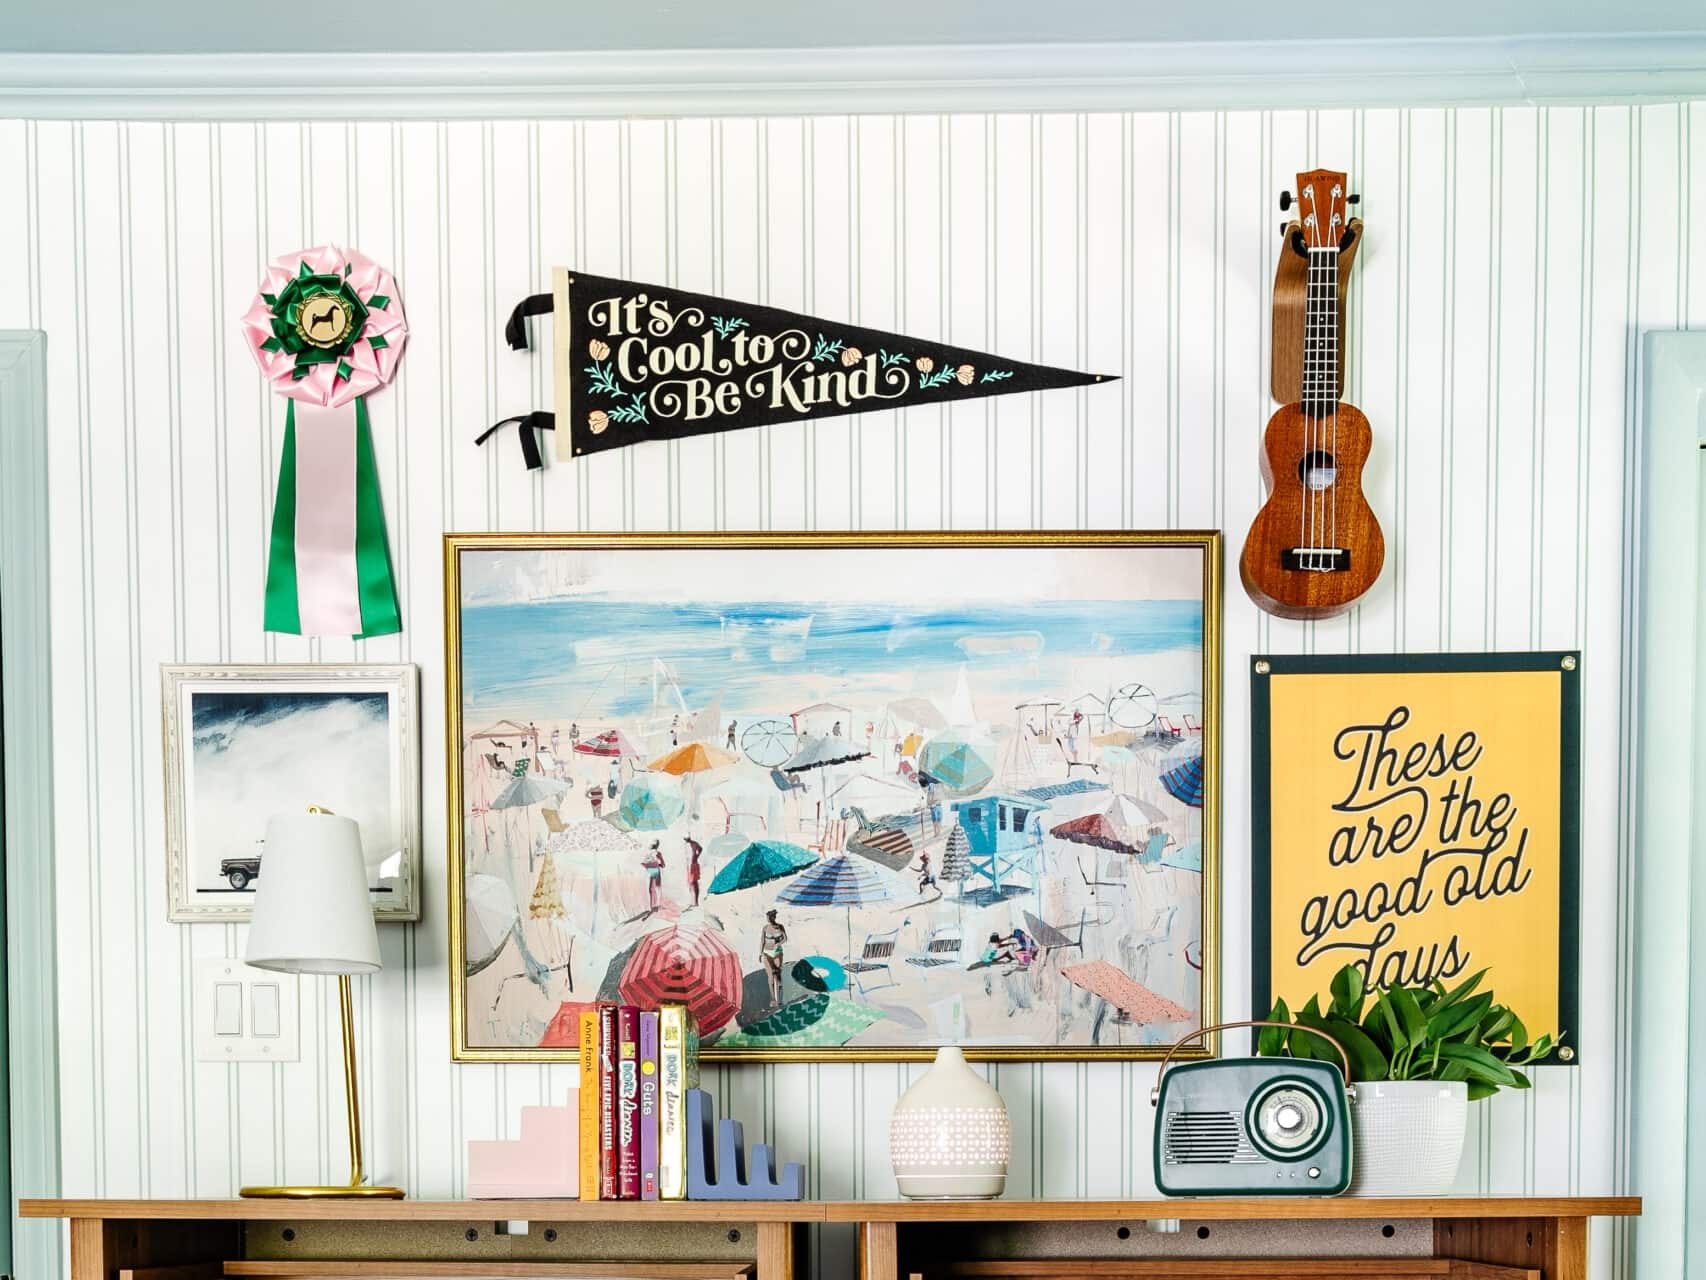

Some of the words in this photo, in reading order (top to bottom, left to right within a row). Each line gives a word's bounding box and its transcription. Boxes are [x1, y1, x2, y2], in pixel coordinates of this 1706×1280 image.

[588, 294, 704, 336] It's
[618, 330, 733, 384] Cool
[732, 329, 811, 367] to
[650, 378, 741, 421] Be
[745, 354, 910, 413] Kind
[1333, 705, 1484, 813] These
[1328, 790, 1429, 867] are
[1440, 776, 1518, 845] the
[1297, 849, 1434, 967] good
[1444, 828, 1533, 905] old
[1343, 923, 1472, 996] days
[585, 1020, 594, 1045] Anne
[584, 1047, 595, 1073] Frank
[622, 1063, 634, 1098] DORK
[665, 1054, 679, 1087] DORK
[643, 1082, 655, 1115] Guts
